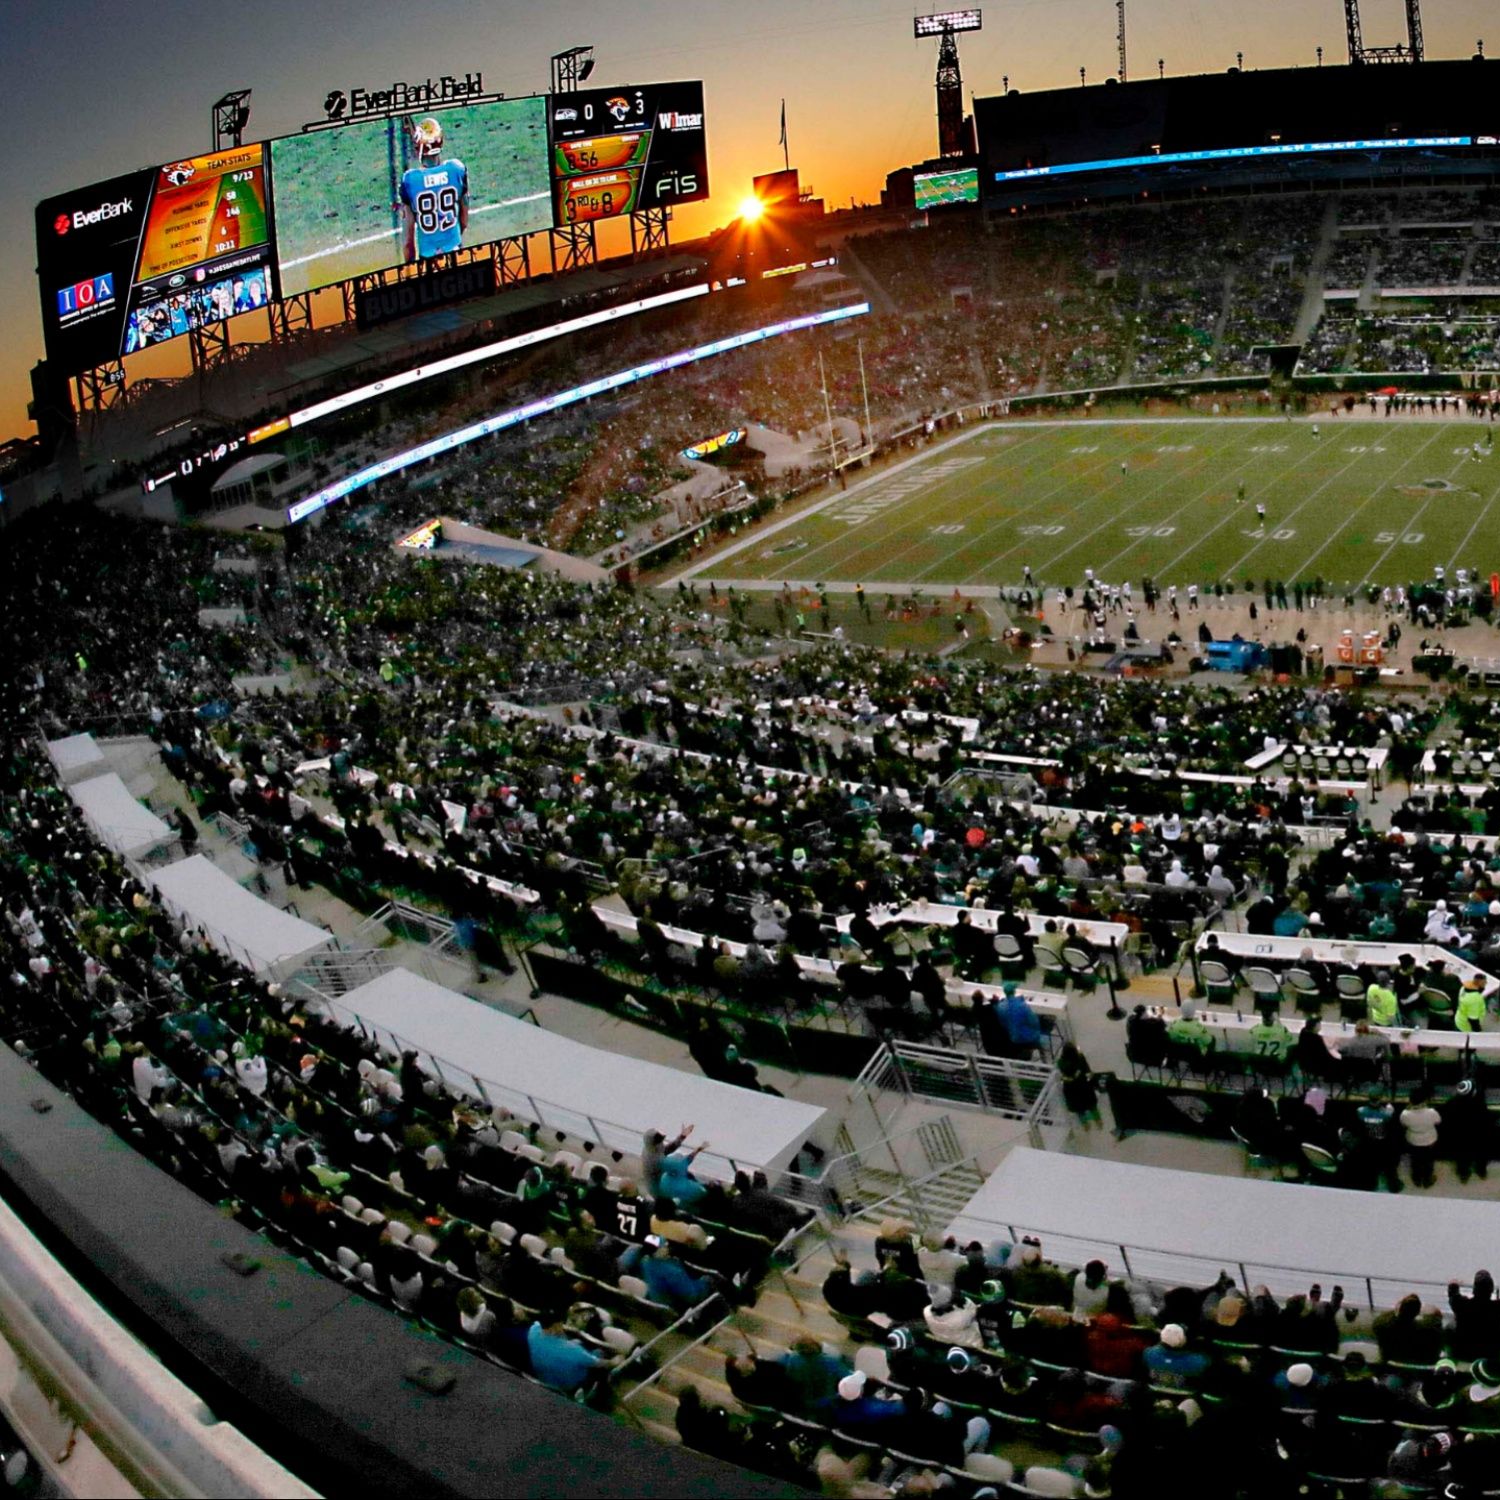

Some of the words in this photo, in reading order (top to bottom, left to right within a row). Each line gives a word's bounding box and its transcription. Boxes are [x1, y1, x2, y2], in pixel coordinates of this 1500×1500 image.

[351, 79, 439, 115] EverBank
[440, 73, 484, 102] Field
[584, 104, 593, 120] 0
[636, 99, 644, 115] 3
[659, 112, 703, 130] Wilmar
[207, 159, 228, 170] TEAM
[228, 153, 251, 166] STATS
[232, 171, 254, 183] 9/13
[424, 170, 449, 188] LEWIS
[656, 175, 698, 198] FIS
[415, 185, 459, 234] 89
[602, 192, 613, 214] 8
[73, 197, 133, 229] EverBank
[64, 279, 112, 311] IOA
[365, 287, 417, 320] BUD
[420, 268, 487, 305] LIGHT
[1127, 526, 1177, 537] 30
[1248, 528, 1297, 541] 40
[1373, 531, 1426, 544] 50
[1366, 651, 1375, 660] G
[1257, 1041, 1281, 1057] 72
[617, 1213, 637, 1236] 27
